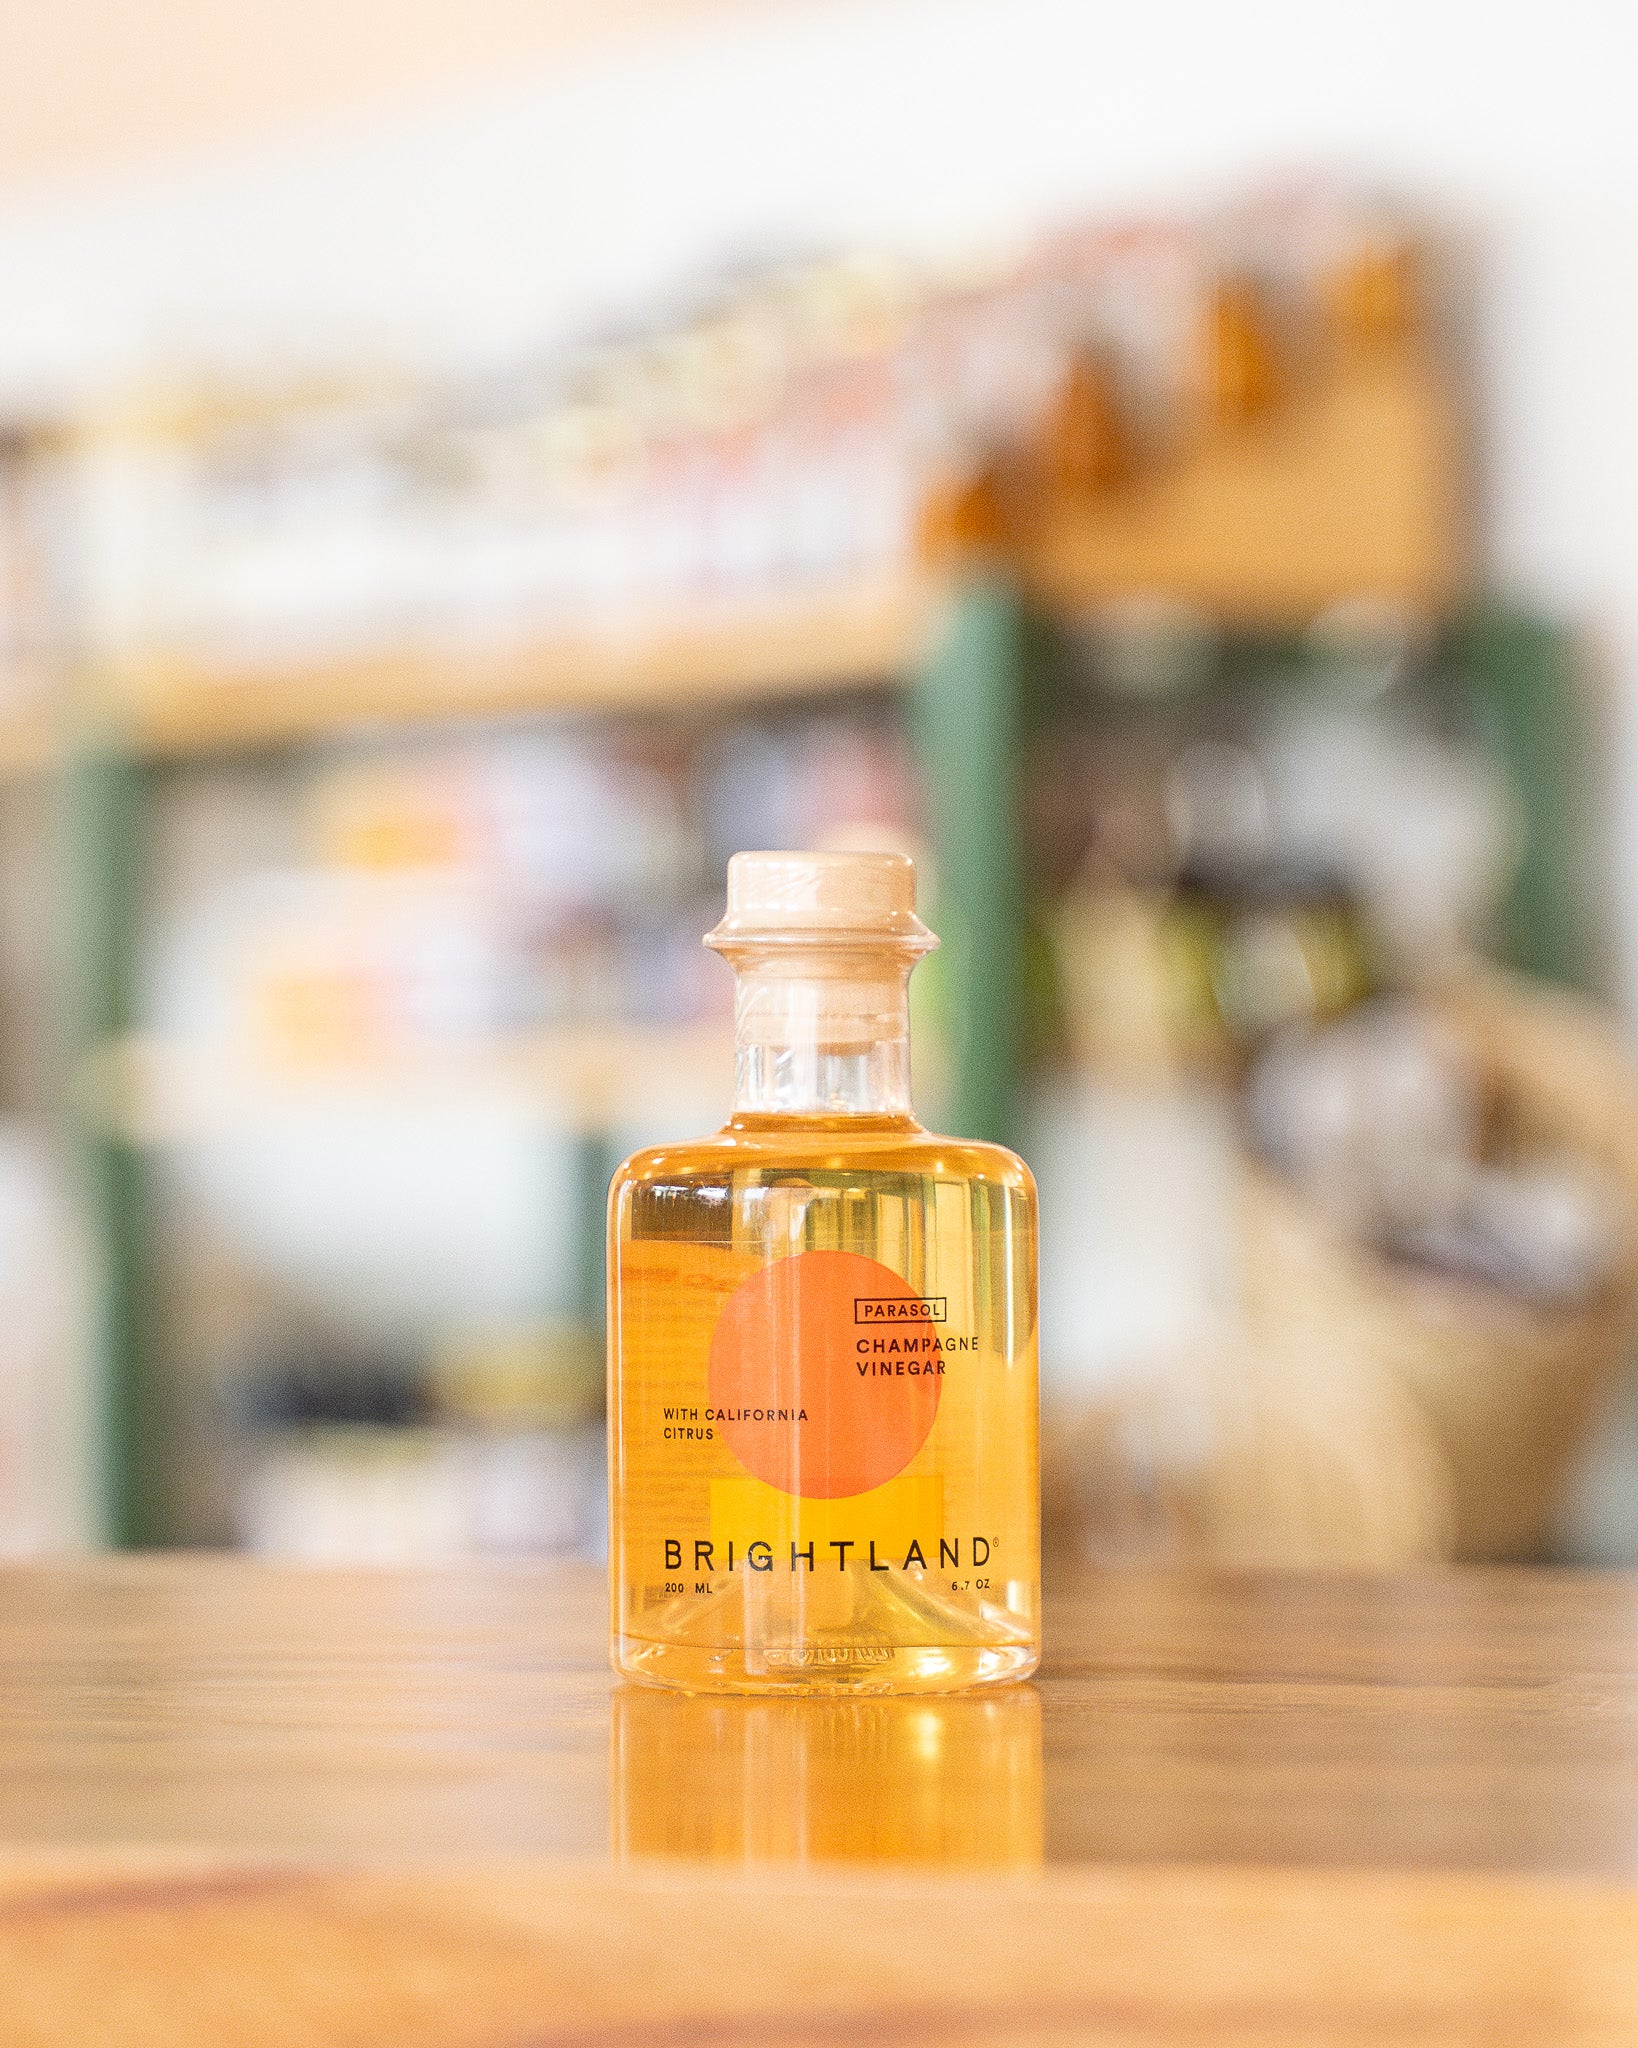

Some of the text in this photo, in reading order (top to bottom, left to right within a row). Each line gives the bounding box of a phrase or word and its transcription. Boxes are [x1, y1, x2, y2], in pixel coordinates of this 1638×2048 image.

[864, 1303, 940, 1317] PARASOL
[856, 1337, 979, 1353] CHAMPAGNE
[856, 1360, 946, 1376] VINEGAR
[663, 1408, 808, 1421] WITH CALIFORNIA
[663, 1427, 714, 1440] CITRUS
[665, 1582, 713, 1594] 200 ML
[951, 1578, 990, 1591] 6.7 OZ
